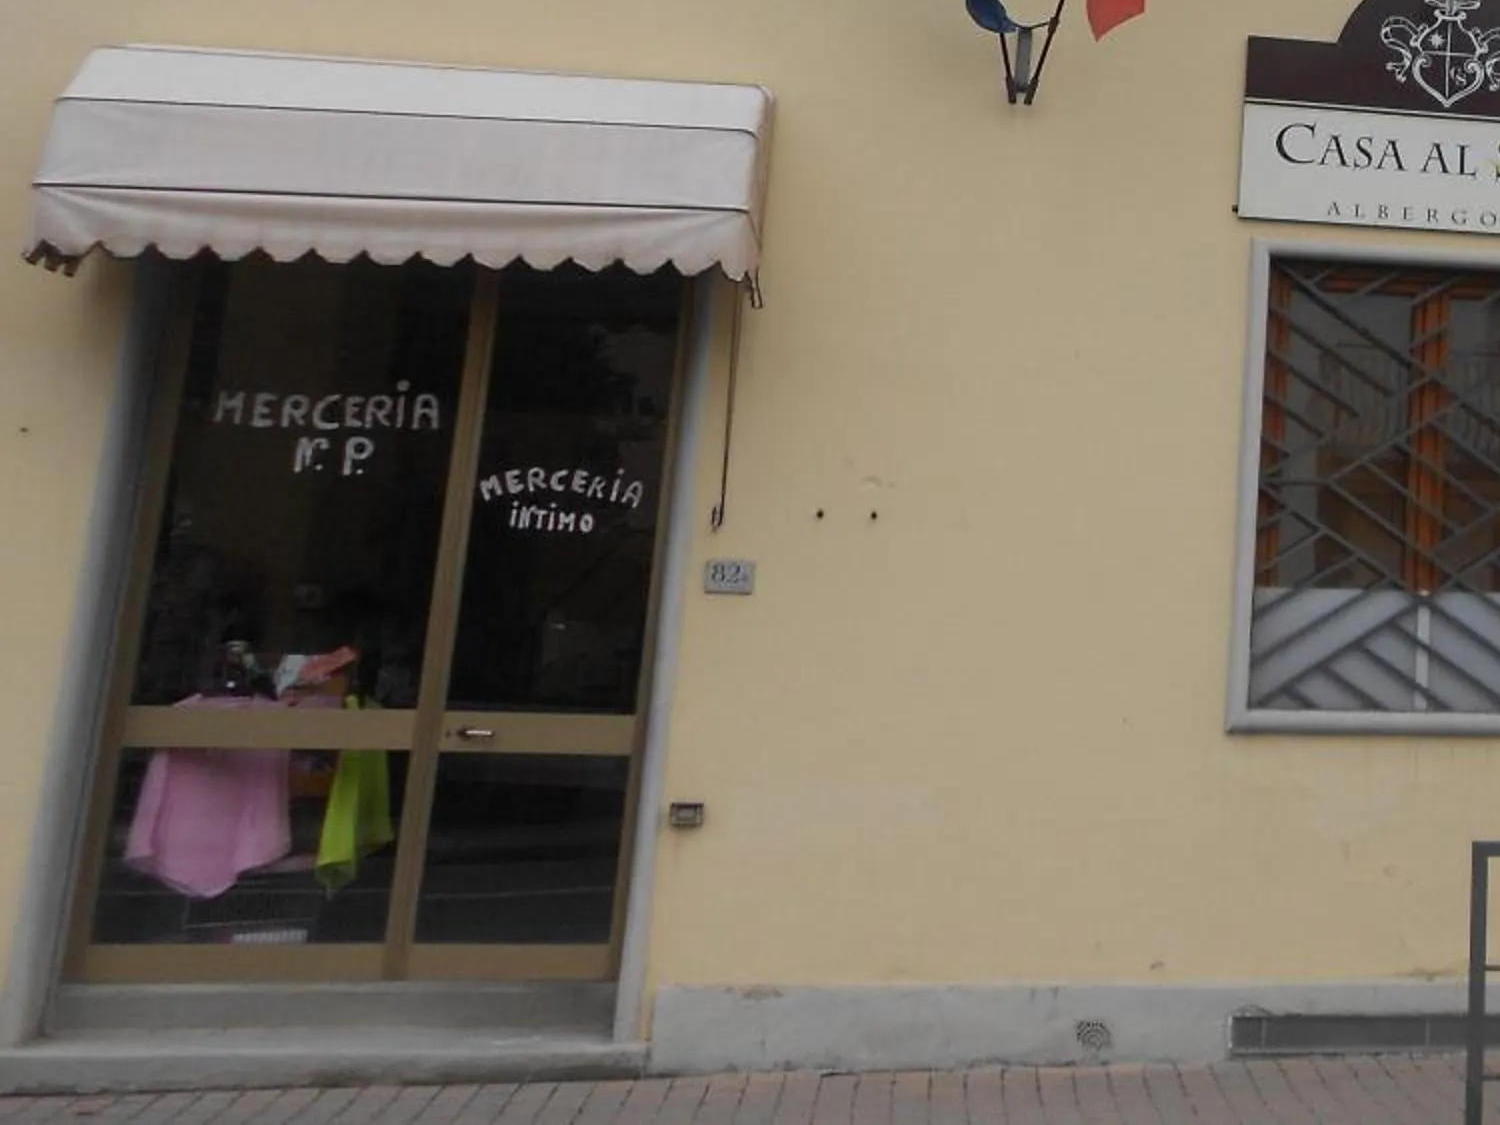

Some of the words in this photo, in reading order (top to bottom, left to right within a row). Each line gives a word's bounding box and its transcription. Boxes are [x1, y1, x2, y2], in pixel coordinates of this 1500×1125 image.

[1275, 122, 1405, 172] CASA
[1421, 142, 1477, 177] AL
[1326, 200, 1498, 227] ALBERGO
